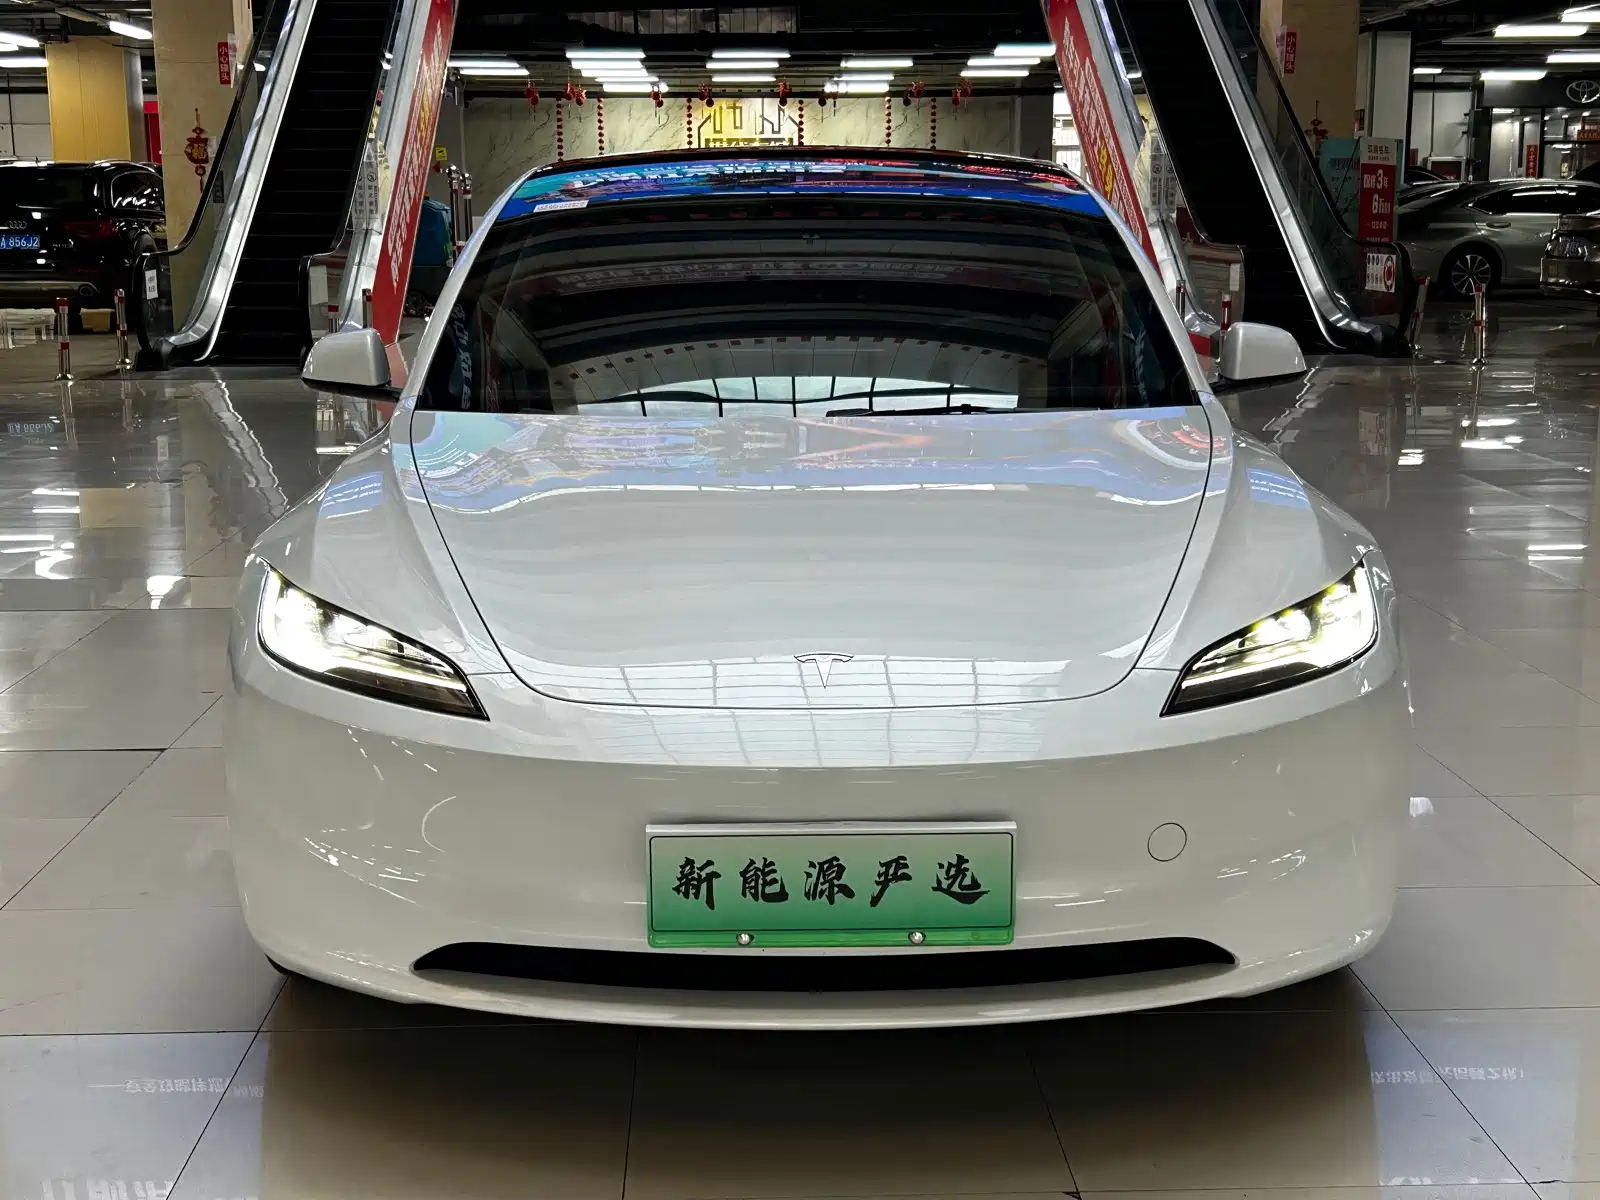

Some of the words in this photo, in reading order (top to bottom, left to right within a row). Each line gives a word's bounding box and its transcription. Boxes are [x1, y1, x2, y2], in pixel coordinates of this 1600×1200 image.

[8, 236, 39, 248] 856J2
[672, 853, 991, 911] 新能源严选
